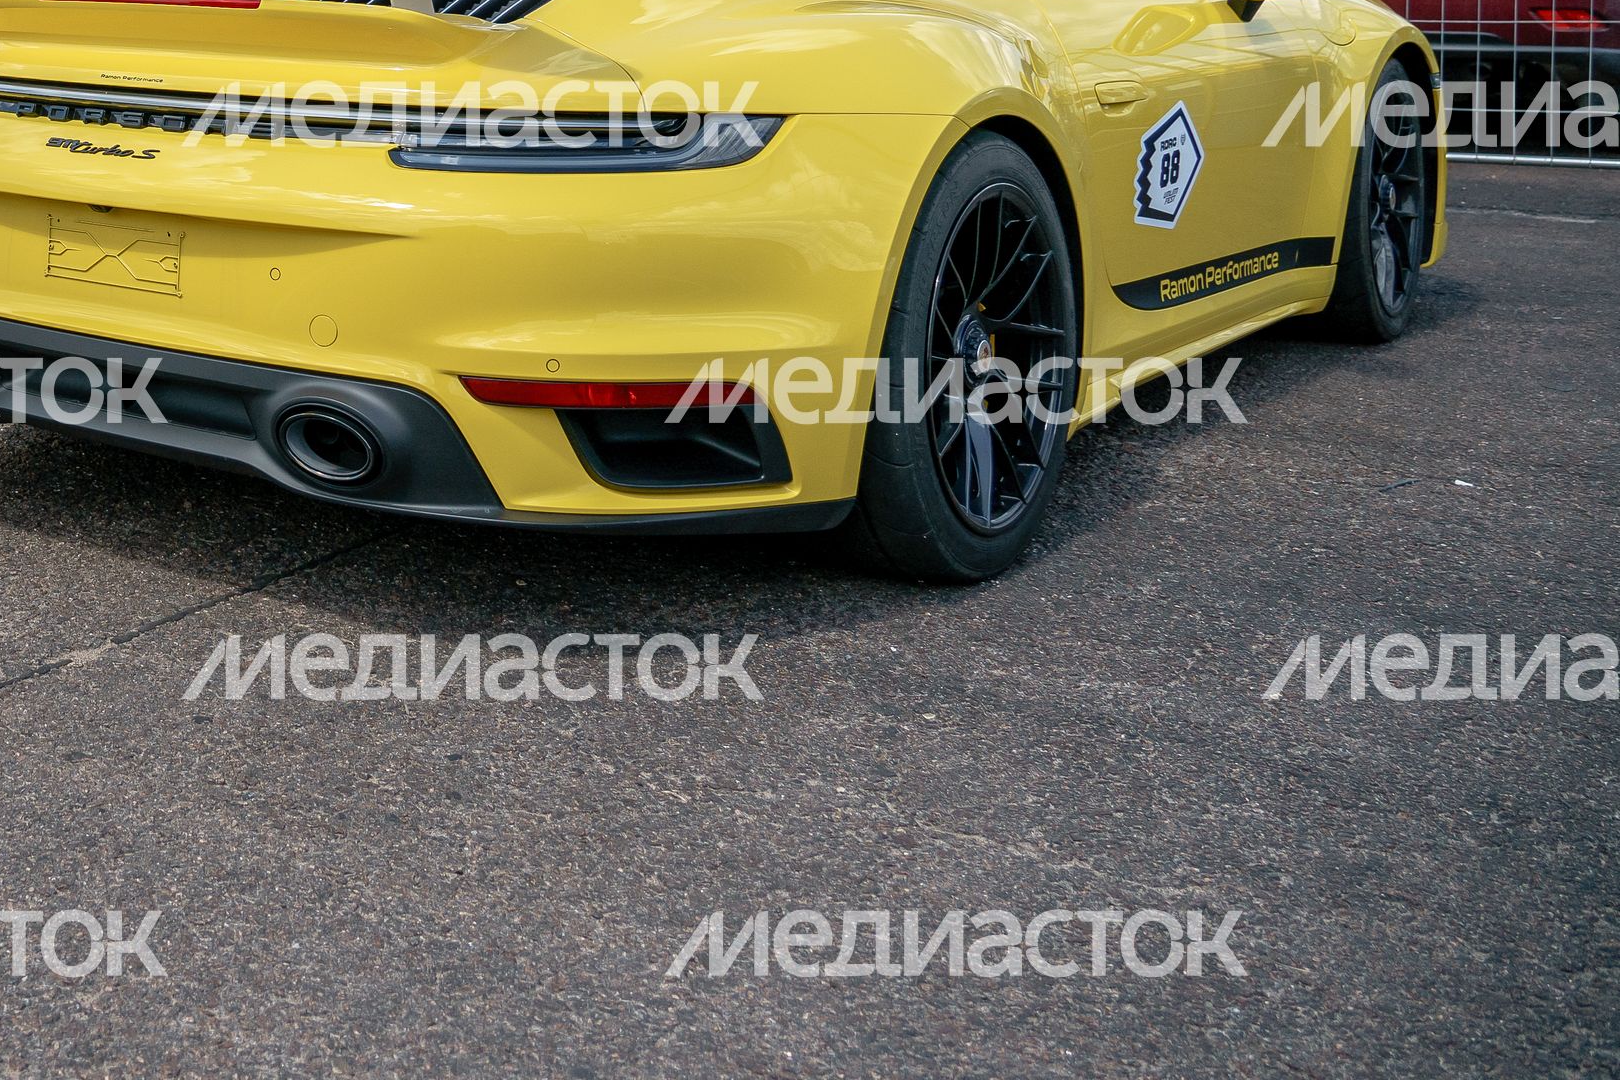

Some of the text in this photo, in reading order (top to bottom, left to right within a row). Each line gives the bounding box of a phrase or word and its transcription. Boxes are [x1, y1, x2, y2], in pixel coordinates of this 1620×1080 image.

[100, 73, 164, 84] Ramon Performance
[15, 101, 279, 140] PORSCHE
[1160, 149, 1180, 189] 88
[1159, 251, 1280, 303] Ramon Performance
